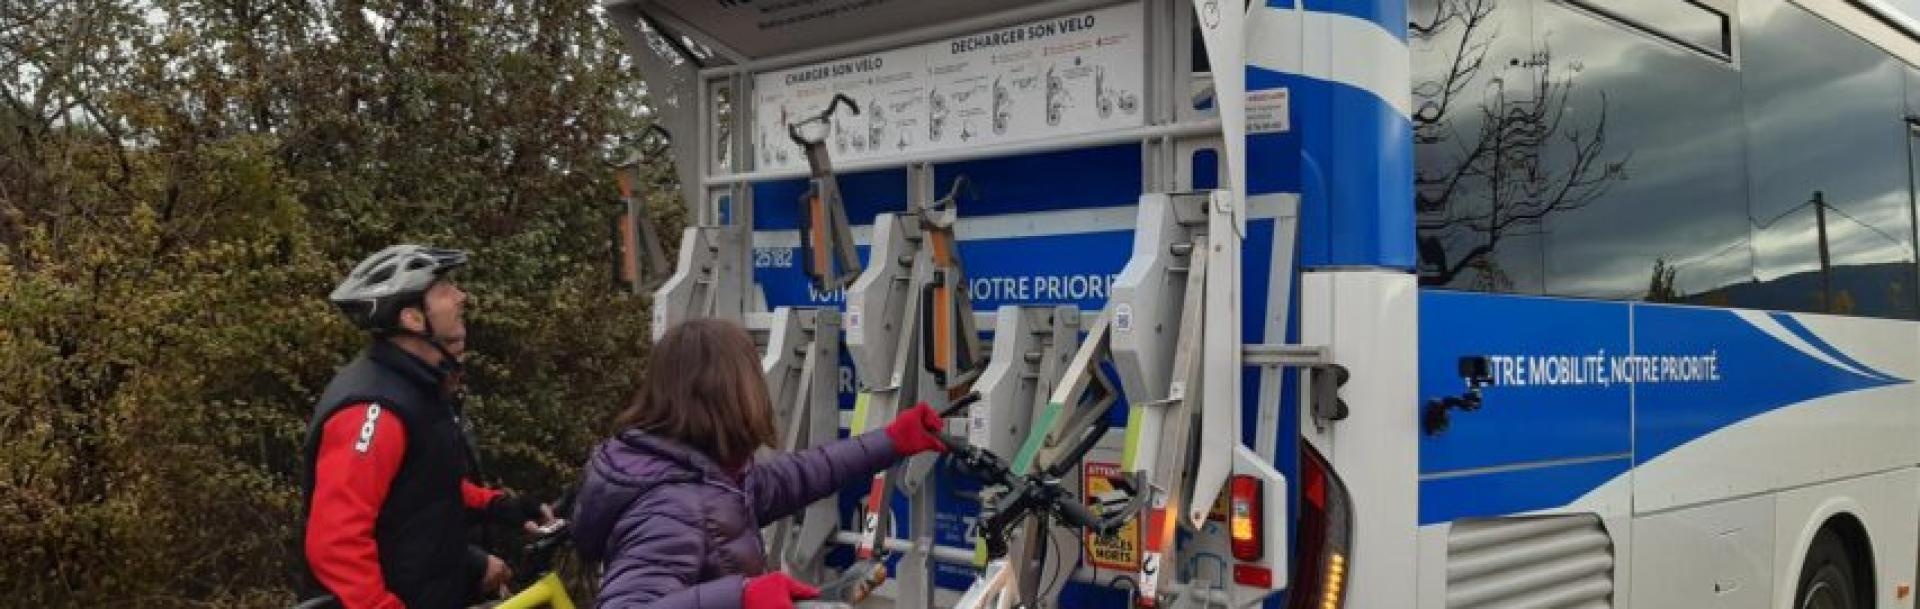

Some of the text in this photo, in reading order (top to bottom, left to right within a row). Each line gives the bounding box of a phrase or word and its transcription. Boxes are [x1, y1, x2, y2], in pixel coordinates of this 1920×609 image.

[951, 27, 1025, 55] DECHARGER
[1028, 23, 1056, 40] SON
[1059, 15, 1096, 35] VELO
[785, 65, 829, 86] CHARGER
[832, 61, 854, 76] SON
[855, 57, 883, 73] VELO
[1488, 356, 1525, 386] TRE
[1611, 356, 1660, 383] NOTRE
